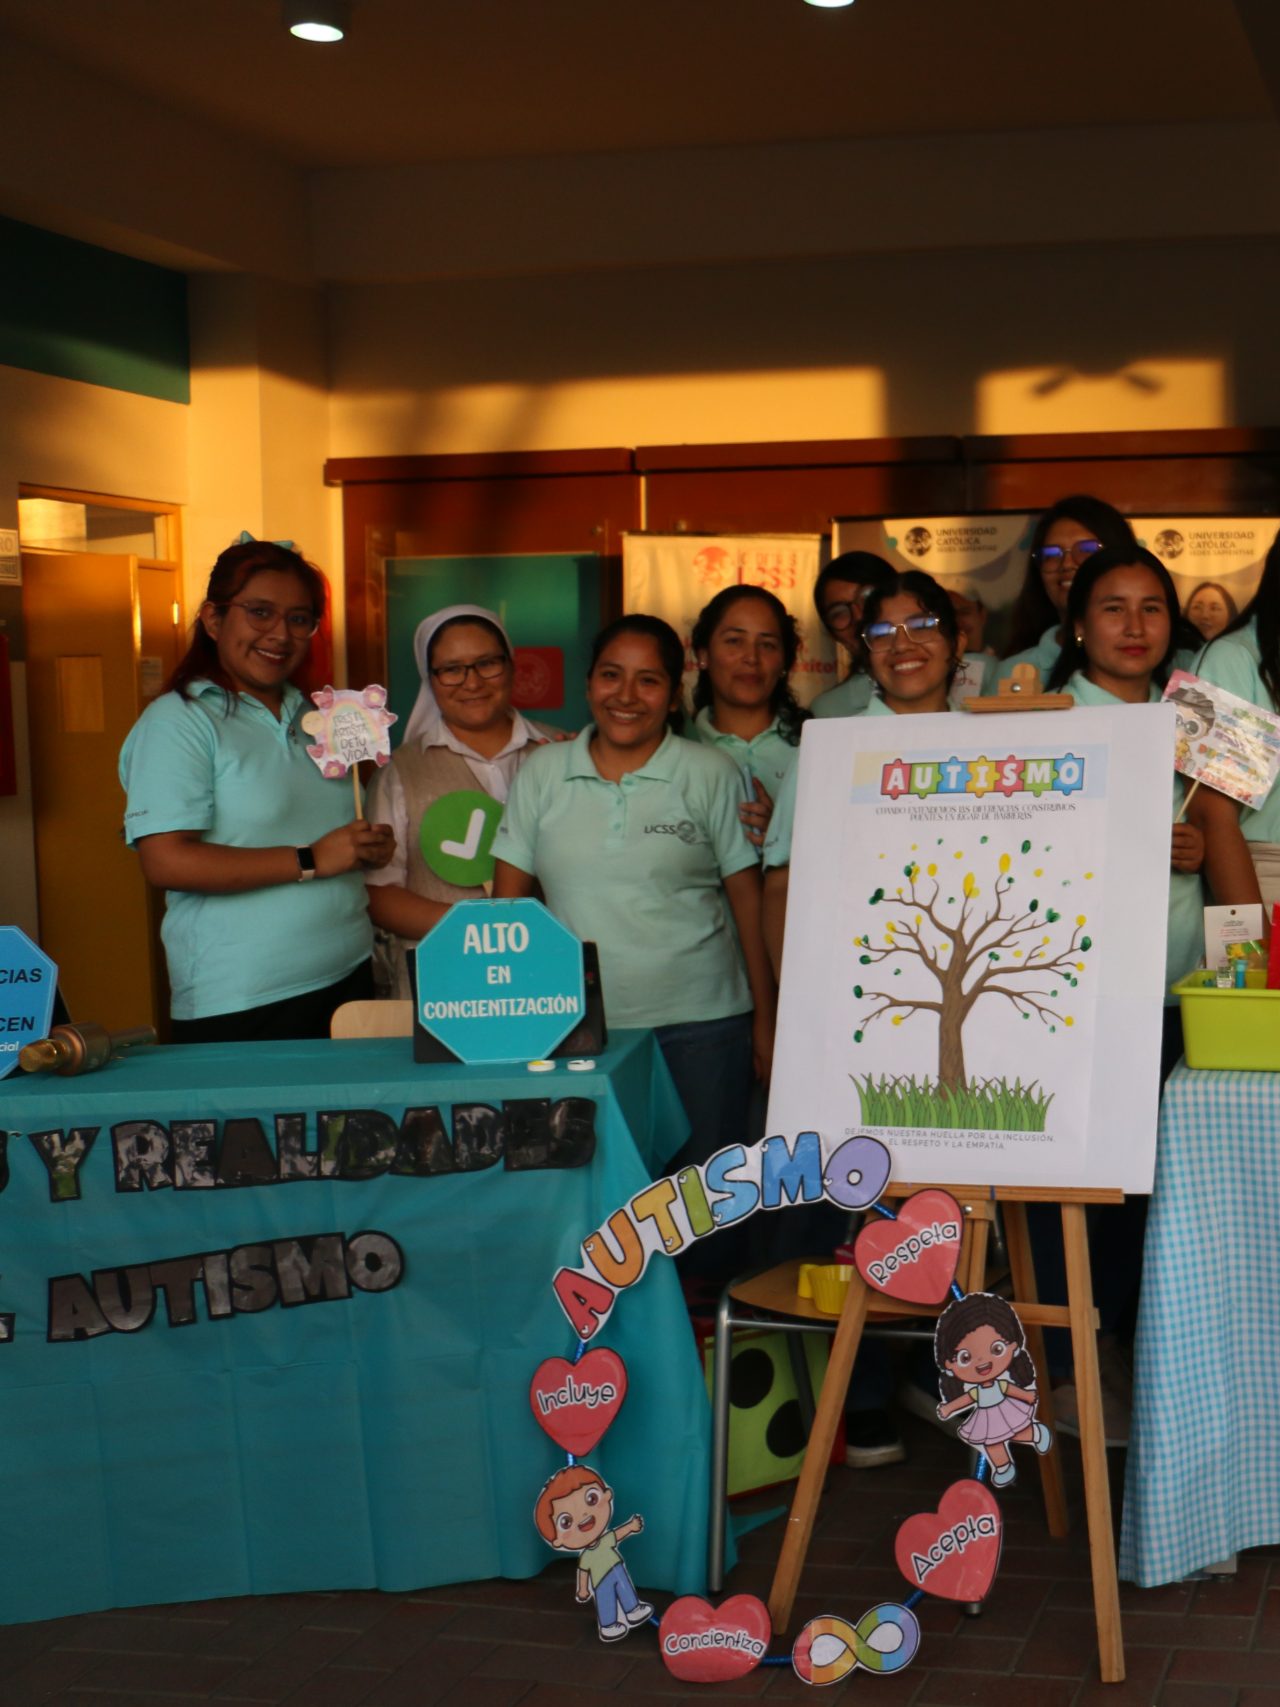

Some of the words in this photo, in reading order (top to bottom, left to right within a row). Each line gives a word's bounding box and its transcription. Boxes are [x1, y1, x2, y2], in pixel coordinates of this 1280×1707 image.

[936, 527, 997, 536] UNIVERSIDAD
[1188, 530, 1255, 540] UNIVERSIDAD
[1188, 540, 1236, 549] CATÓLICA
[342, 746, 373, 762] VIDA
[886, 761, 1081, 791] AUTISMO
[644, 824, 677, 835] UCSS
[463, 922, 530, 956] ALTO
[486, 966, 512, 985] EN
[423, 994, 579, 1020] CONCIENTIZACIÓN
[845, 1128, 884, 1136] DEJEMOS
[887, 1129, 927, 1137] NUESTRA
[930, 1130, 965, 1139] HUELLA
[989, 1132, 1000, 1140] LA
[888, 1138, 899, 1146] EL
[902, 1139, 941, 1147] RESPETO
[28, 1127, 99, 1202] Y
[111, 1098, 597, 1193] REALIDADES
[553, 1131, 892, 1339] AUTISMO
[868, 1220, 958, 1286] Respeta
[47, 1230, 405, 1343] AUTISMO
[536, 1376, 615, 1413] Incluye
[911, 1513, 996, 1583] Acepta
[664, 1628, 766, 1656] Concientiza
